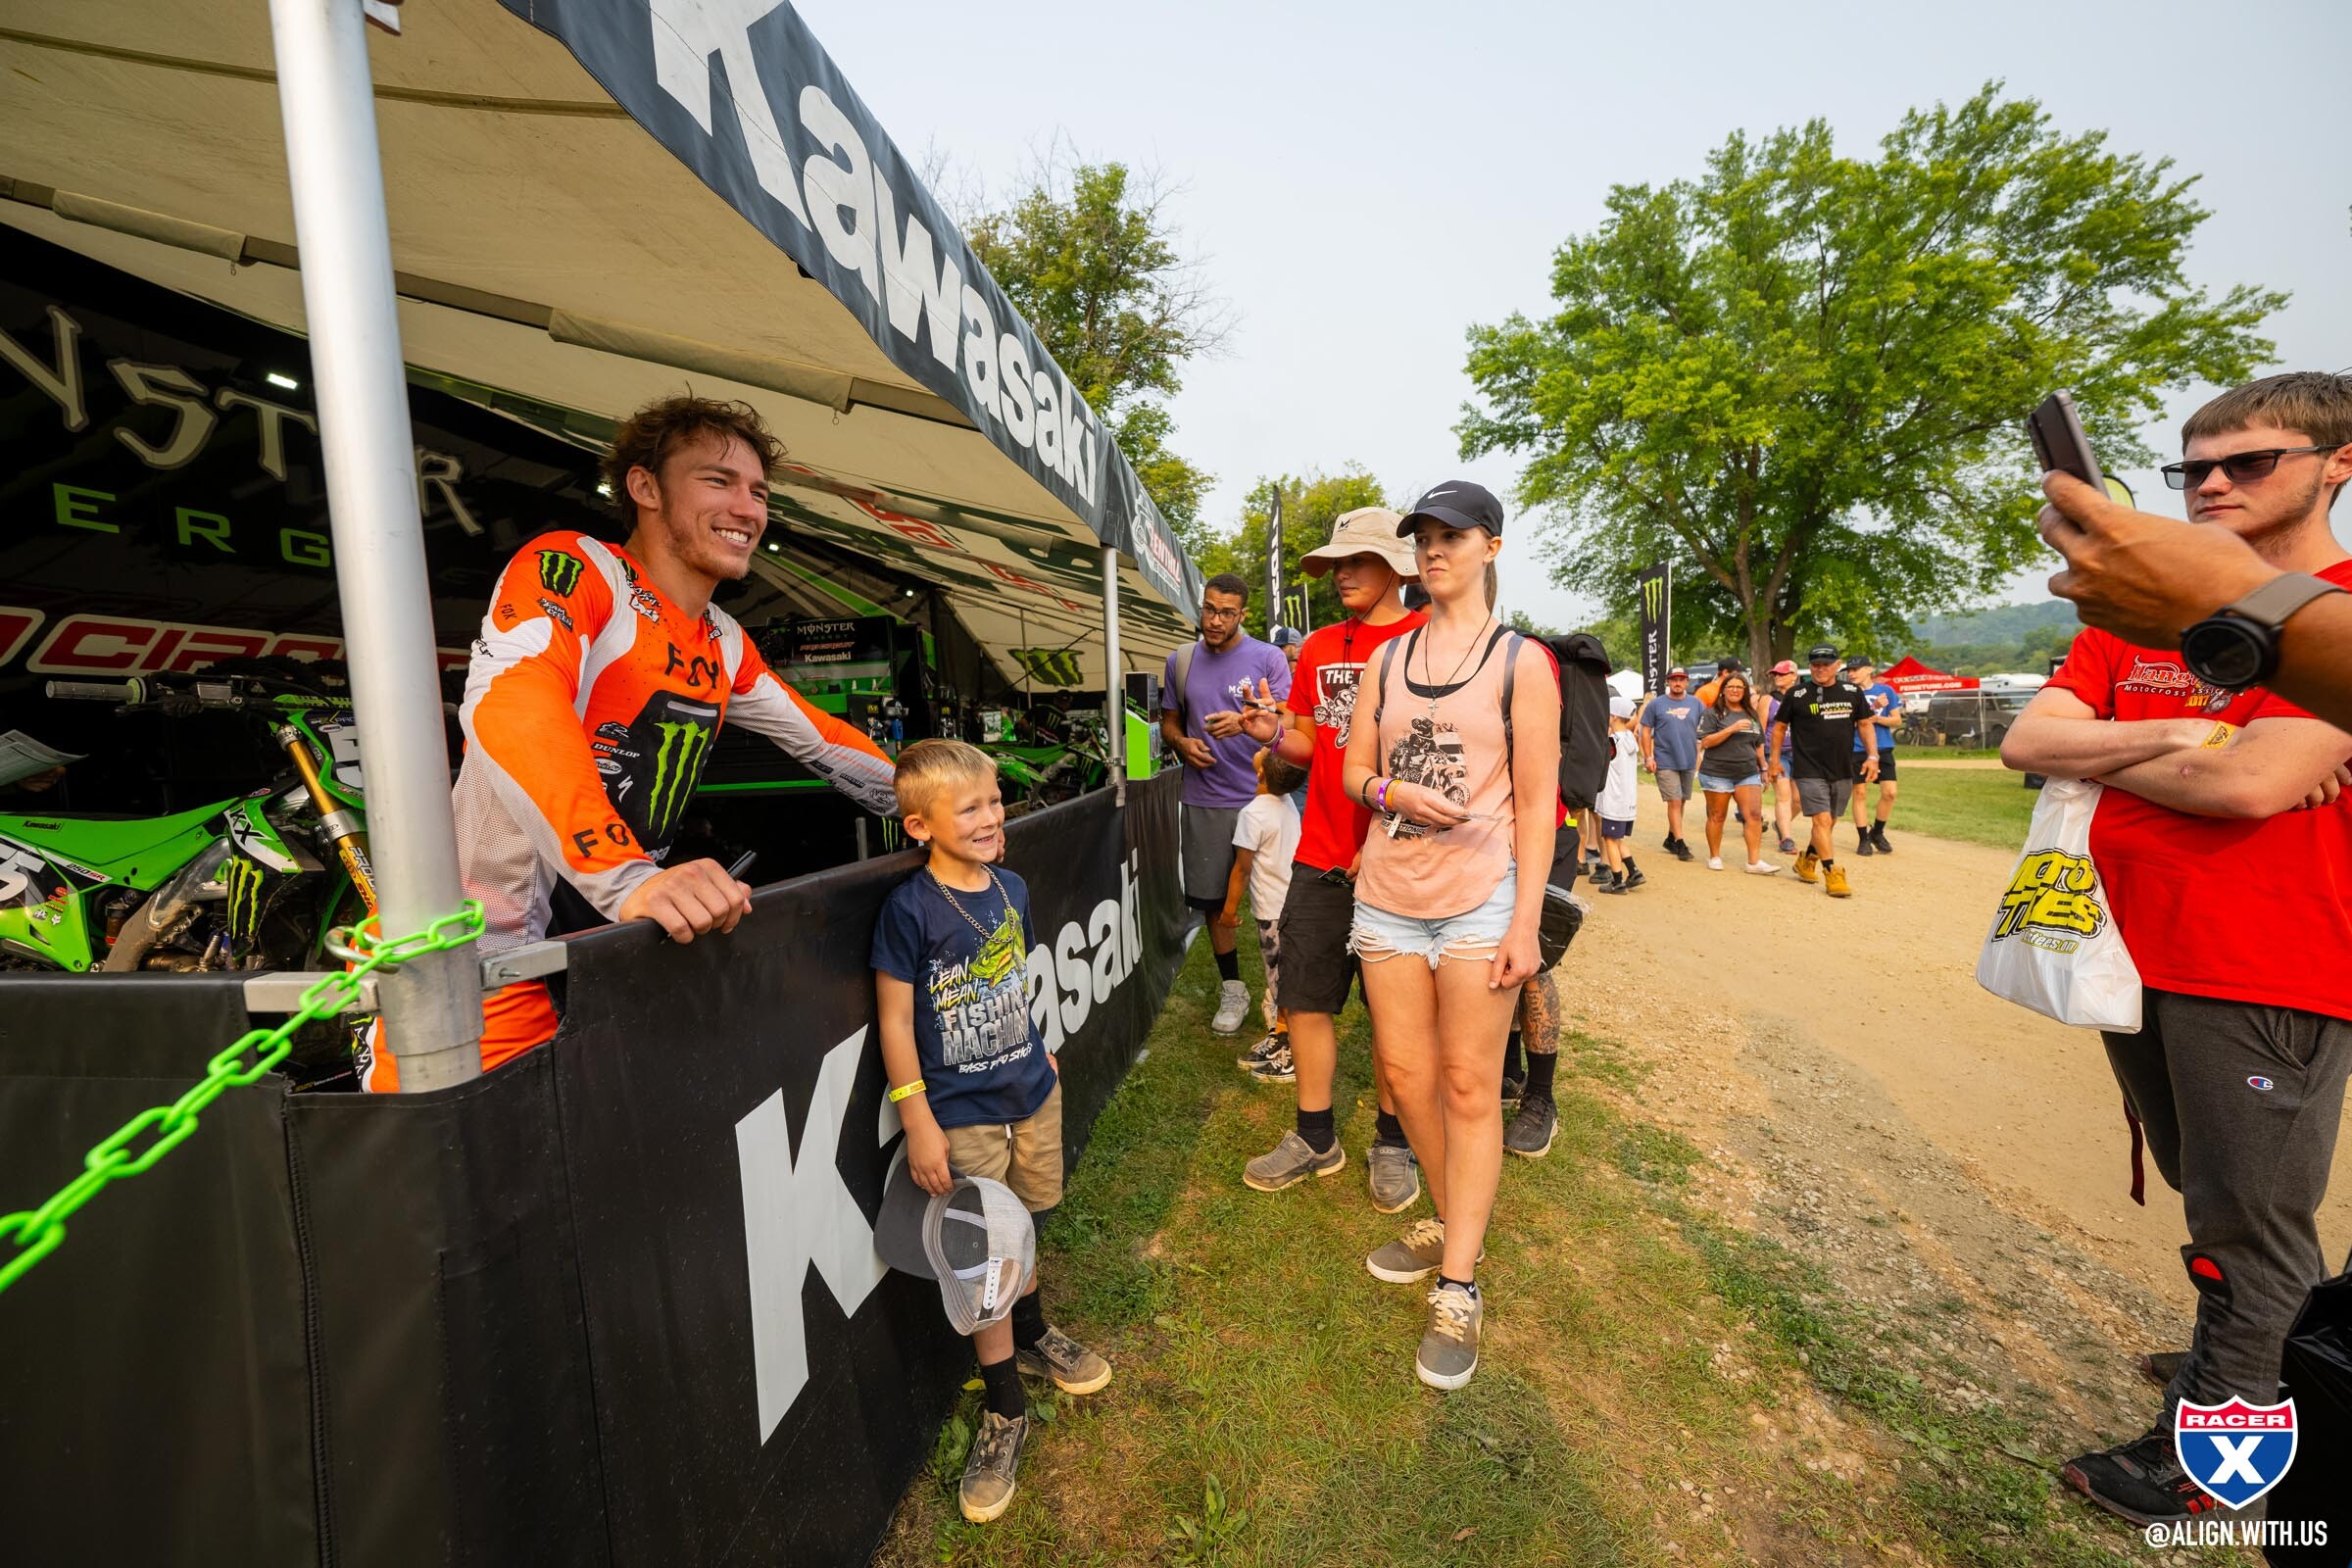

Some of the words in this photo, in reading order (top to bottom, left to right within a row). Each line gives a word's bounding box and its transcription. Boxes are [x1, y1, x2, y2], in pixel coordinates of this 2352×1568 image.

[649, 0, 1096, 508] Kawasaki
[501, 604, 517, 619] FOX
[797, 622, 856, 636] MONSTER
[804, 651, 852, 663] Kawasaki
[1325, 669, 1353, 684] THE
[592, 743, 640, 759] DUNLOP
[228, 807, 267, 846] KX
[572, 822, 630, 858] FO
[66, 862, 105, 882] 250SR
[929, 956, 973, 995] LEAN,
[934, 978, 980, 1013] MEAN,
[941, 1005, 1029, 1066] MACHIN
[958, 1059, 990, 1074] BASS
[735, 847, 1143, 1447] Kasaki
